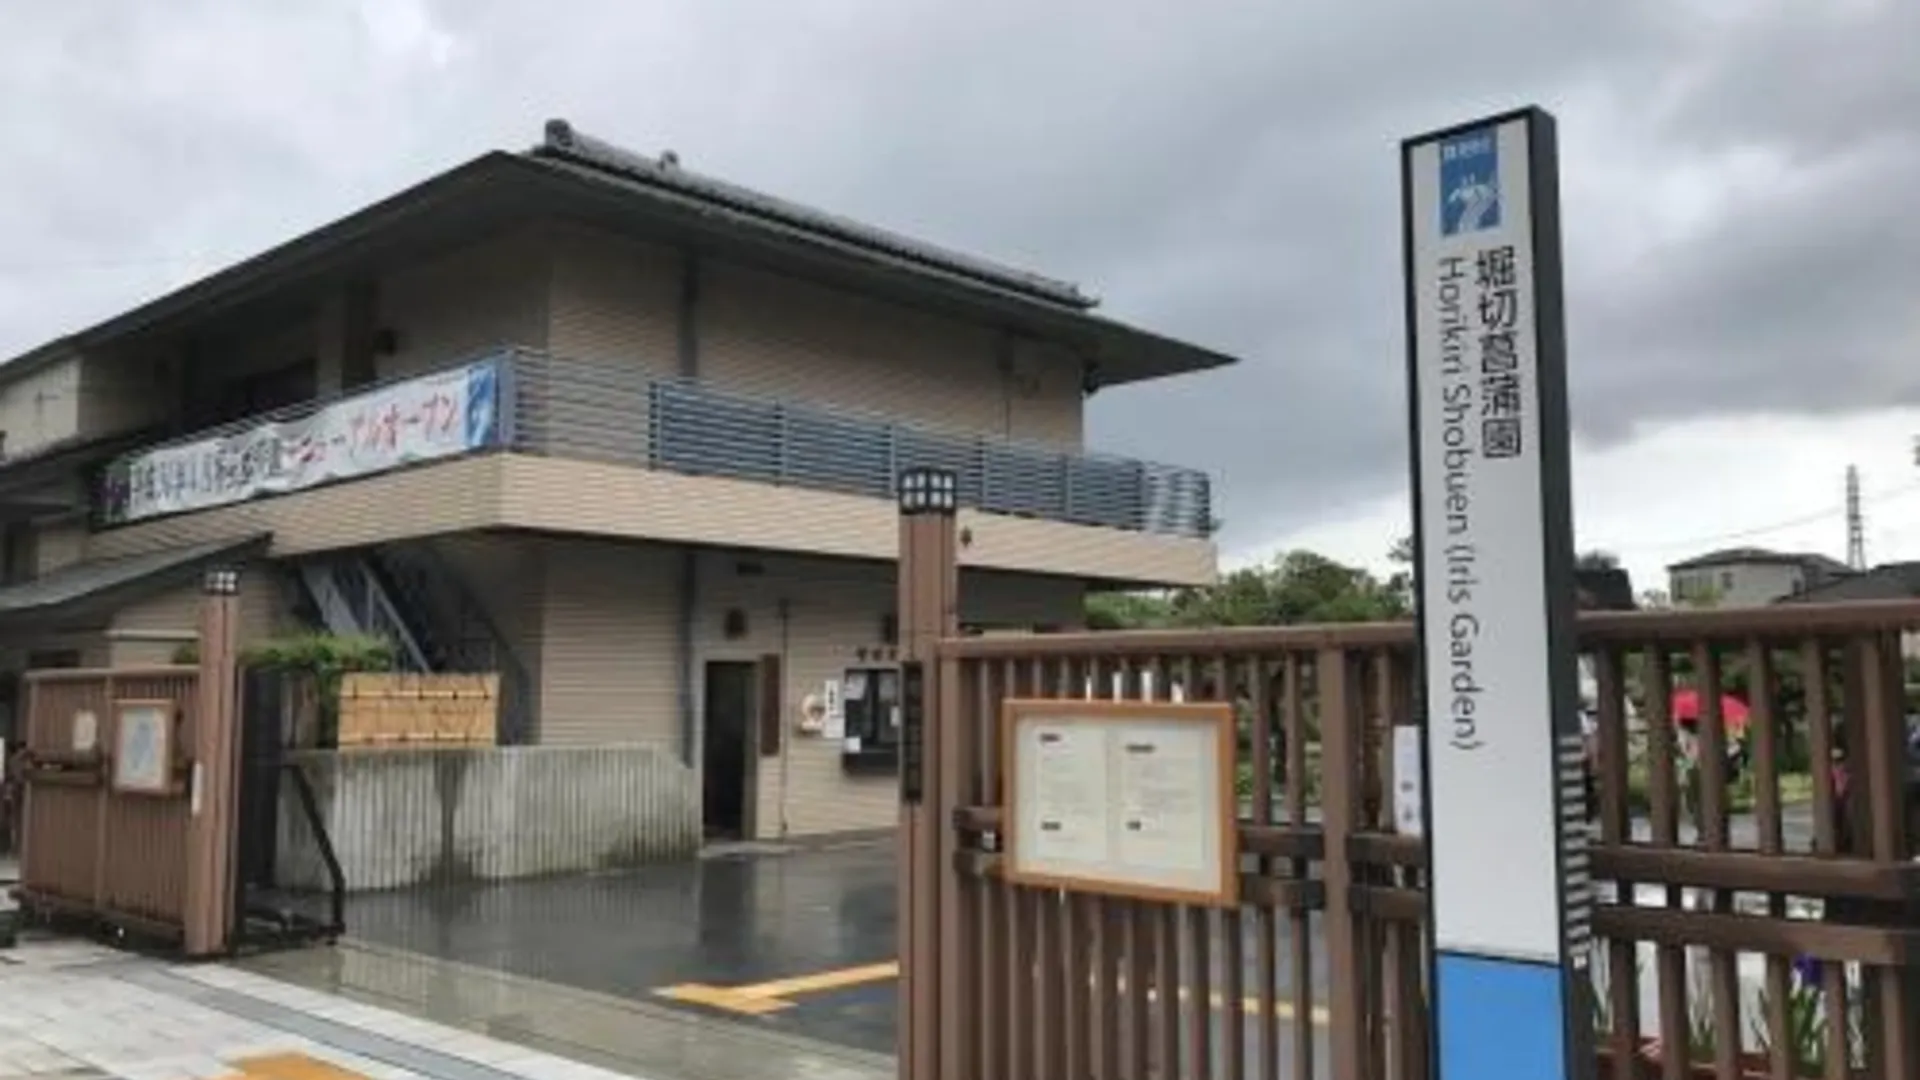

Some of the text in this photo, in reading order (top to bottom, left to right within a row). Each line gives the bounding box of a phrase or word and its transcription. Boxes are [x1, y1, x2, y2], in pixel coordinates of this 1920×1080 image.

[1438, 257, 1487, 751] Horikiri Shobuen (Iris Garden)
[1475, 245, 1522, 459] 堀切菖蒲園
